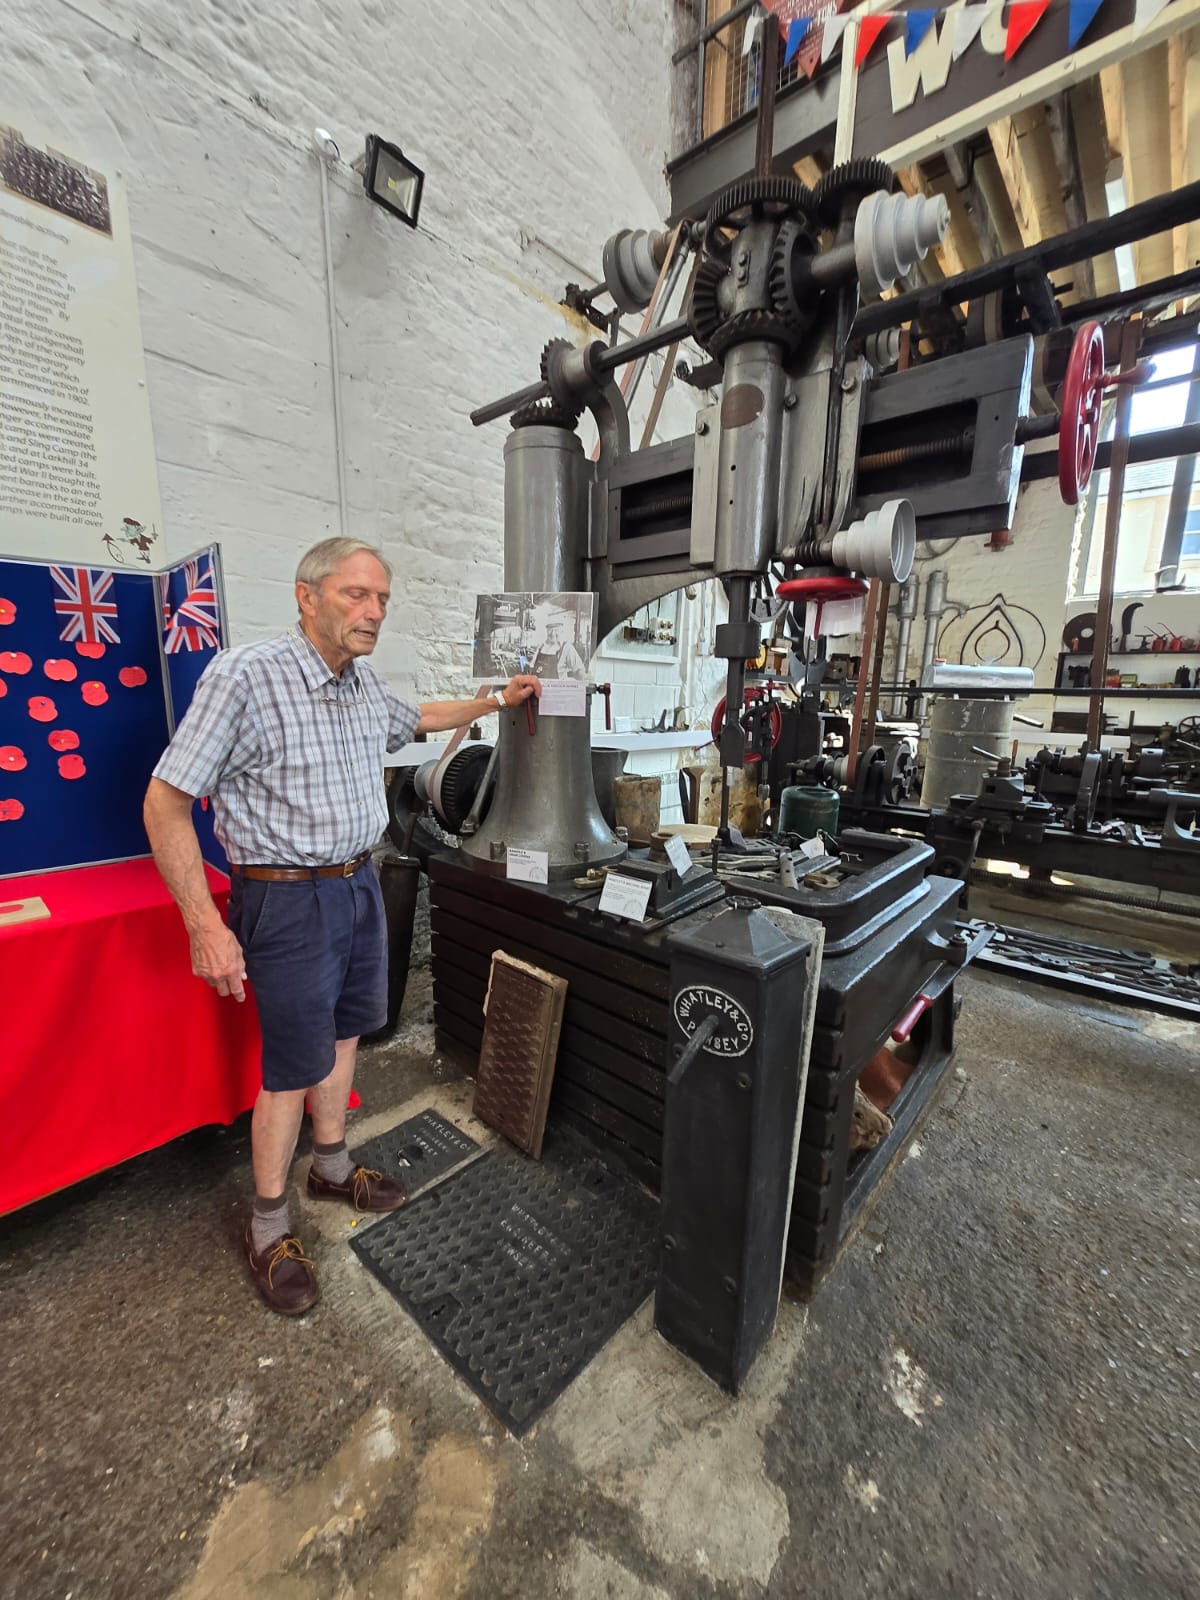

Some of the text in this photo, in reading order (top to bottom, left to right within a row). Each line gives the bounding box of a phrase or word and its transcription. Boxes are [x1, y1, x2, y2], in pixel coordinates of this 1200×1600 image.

[67, 283, 76, 293] In
[4, 322, 84, 355] from Ludgershall
[54, 331, 82, 345] covers
[18, 348, 69, 371] temporary
[37, 344, 52, 355] the
[54, 351, 85, 367] county
[18, 369, 78, 393] Construction
[80, 387, 89, 396] of
[41, 366, 51, 374] of
[53, 370, 80, 383] which
[57, 390, 65, 399] in
[68, 393, 90, 406] 1902.
[44, 412, 58, 423] the
[60, 418, 94, 433] existing
[51, 405, 92, 423] increased
[4, 424, 36, 437] camps
[38, 431, 60, 442] were
[24, 419, 91, 441] accommodate
[6, 434, 97, 461] and Sling Camp (the
[9, 445, 89, 468] and at Larkhill 34
[18, 457, 50, 471] camps
[51, 464, 73, 474] were
[75, 468, 96, 480] built.
[20, 465, 39, 478] War
[48, 471, 85, 487] brought
[86, 481, 101, 490] the
[1, 484, 97, 508] increase in the size of
[19, 476, 58, 491] barracks
[60, 485, 70, 494] to
[71, 487, 83, 495] an
[84, 490, 102, 500] end,
[25, 508, 48, 518] were
[50, 511, 70, 522] built
[72, 515, 83, 524] all
[84, 519, 103, 528] over
[29, 499, 104, 519] accommodation,
[680, 991, 733, 1017] WHATLEY
[686, 1020, 739, 1051] PSEY
